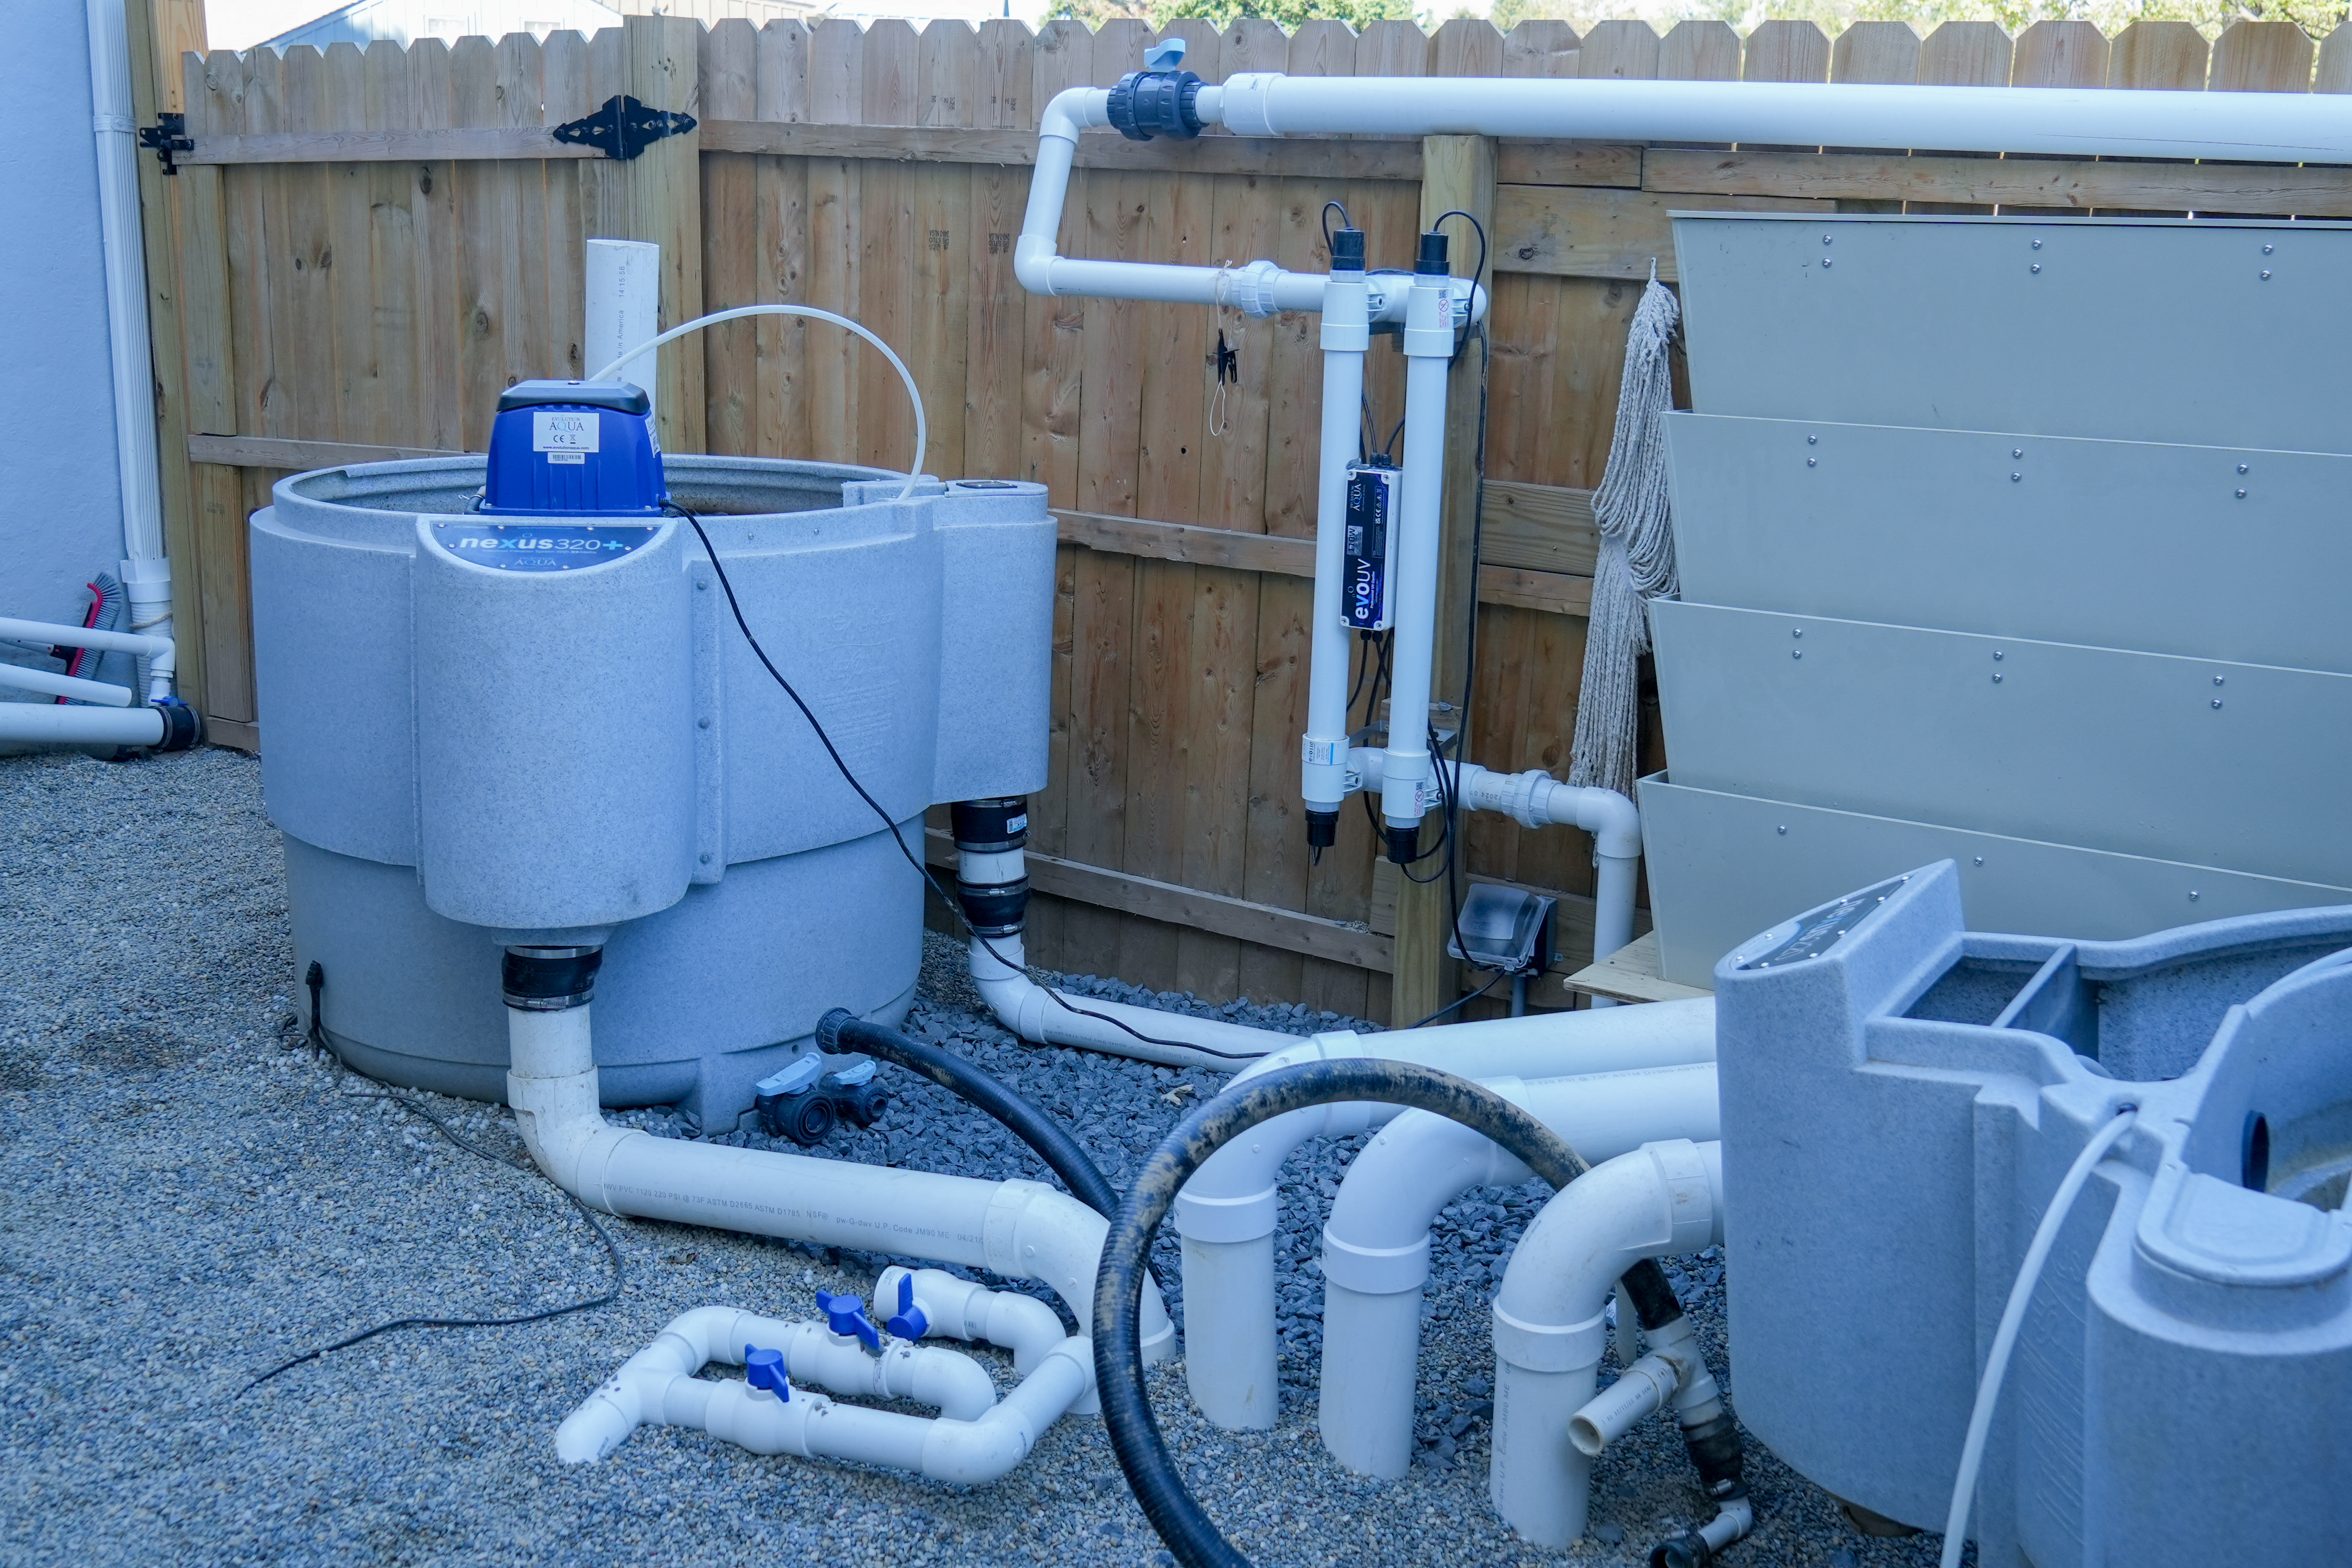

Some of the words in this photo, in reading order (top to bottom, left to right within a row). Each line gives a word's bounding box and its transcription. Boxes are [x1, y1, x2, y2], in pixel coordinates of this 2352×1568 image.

[549, 422, 584, 433] AQUA
[1353, 483, 1362, 511] AQUA
[619, 1185, 633, 1193] PVC
[636, 1188, 652, 1196] 1120
[683, 1194, 690, 1203] @
[707, 1198, 727, 1207] ASTM
[730, 1200, 753, 1209] D2665
[754, 1204, 775, 1214] ASTM
[777, 1208, 800, 1217] D1785
[836, 1216, 872, 1227] pw-G-dwv
[874, 1221, 890, 1230] U.P.
[893, 1224, 913, 1233] Code
[915, 1227, 936, 1236] JM90
[938, 1230, 950, 1239] ME
[1504, 1382, 1510, 1399] ME
